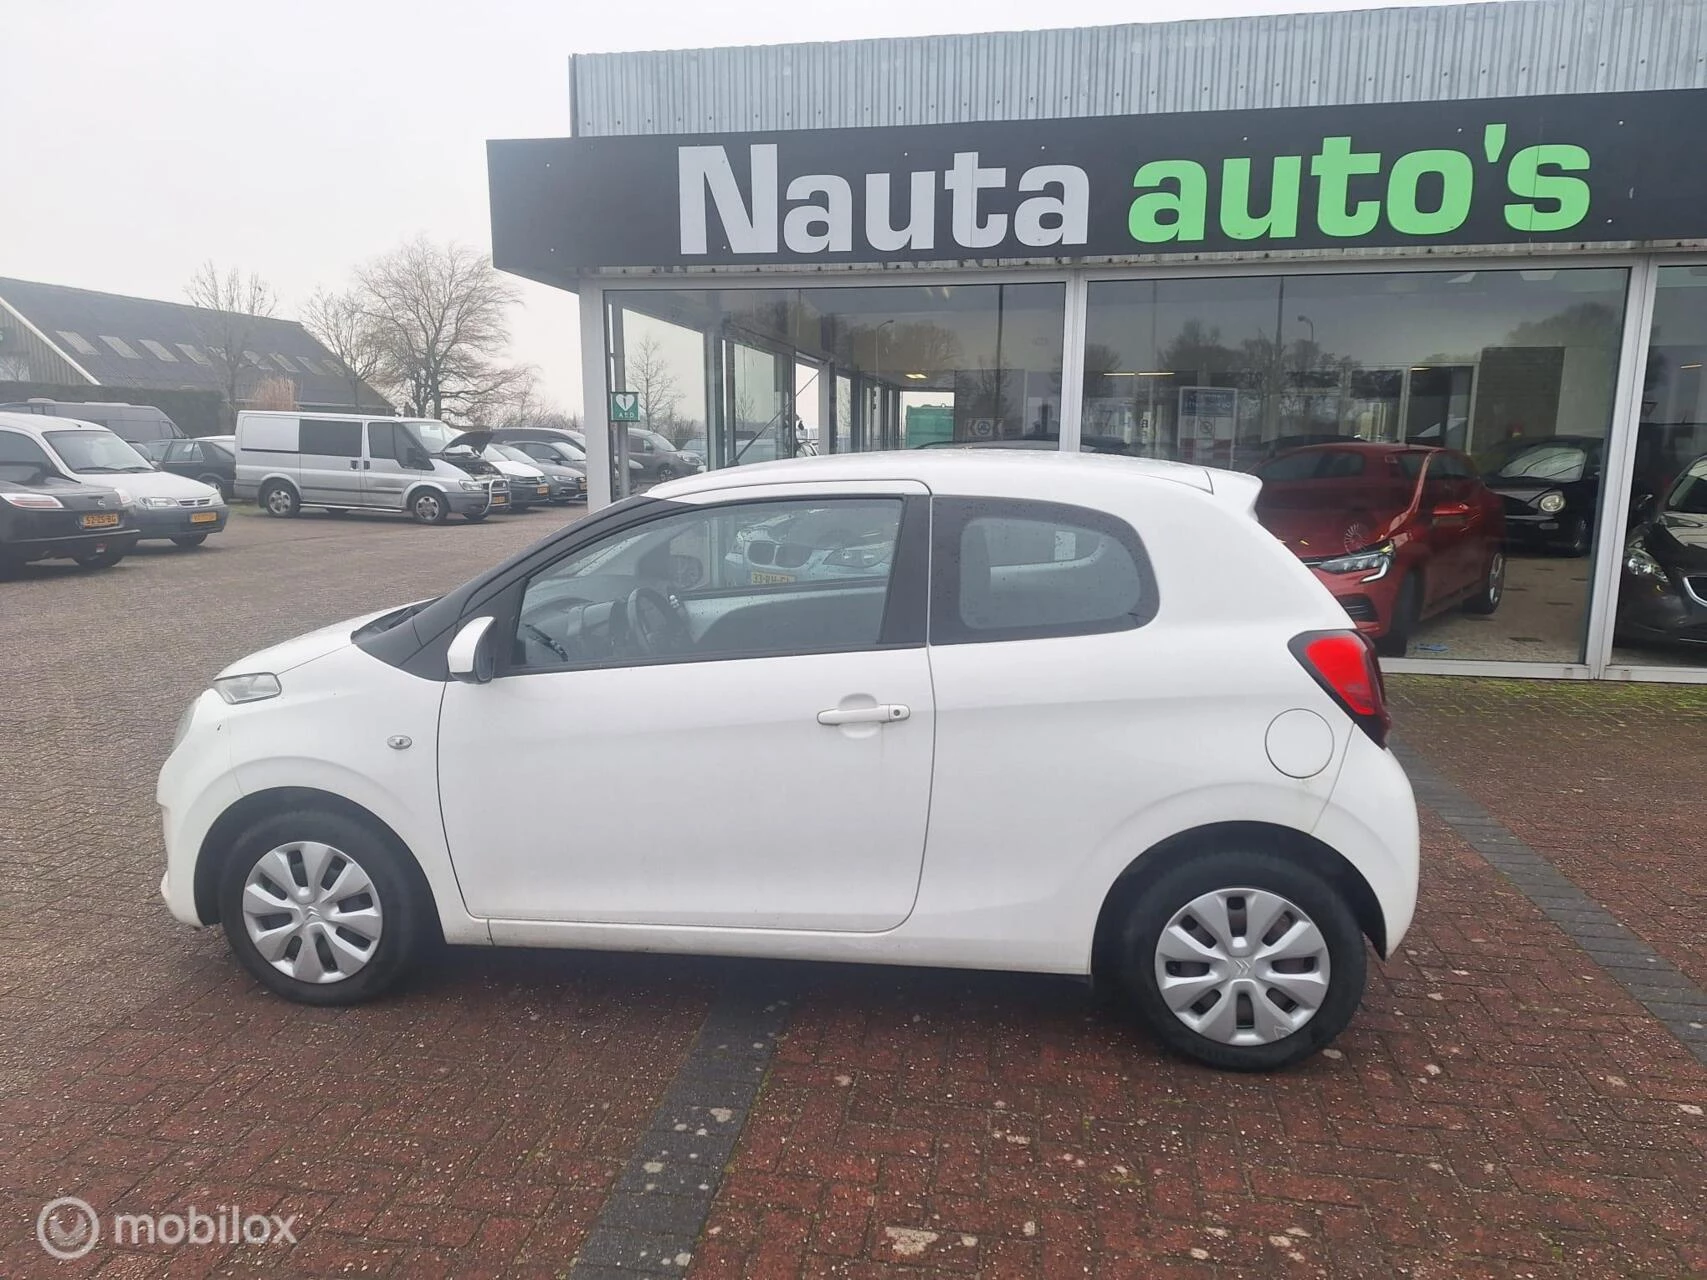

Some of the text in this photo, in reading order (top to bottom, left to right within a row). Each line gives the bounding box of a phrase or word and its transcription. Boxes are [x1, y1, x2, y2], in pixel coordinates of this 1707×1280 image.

[677, 123, 1592, 255] Nauta auto's
[617, 411, 636, 419] AED
